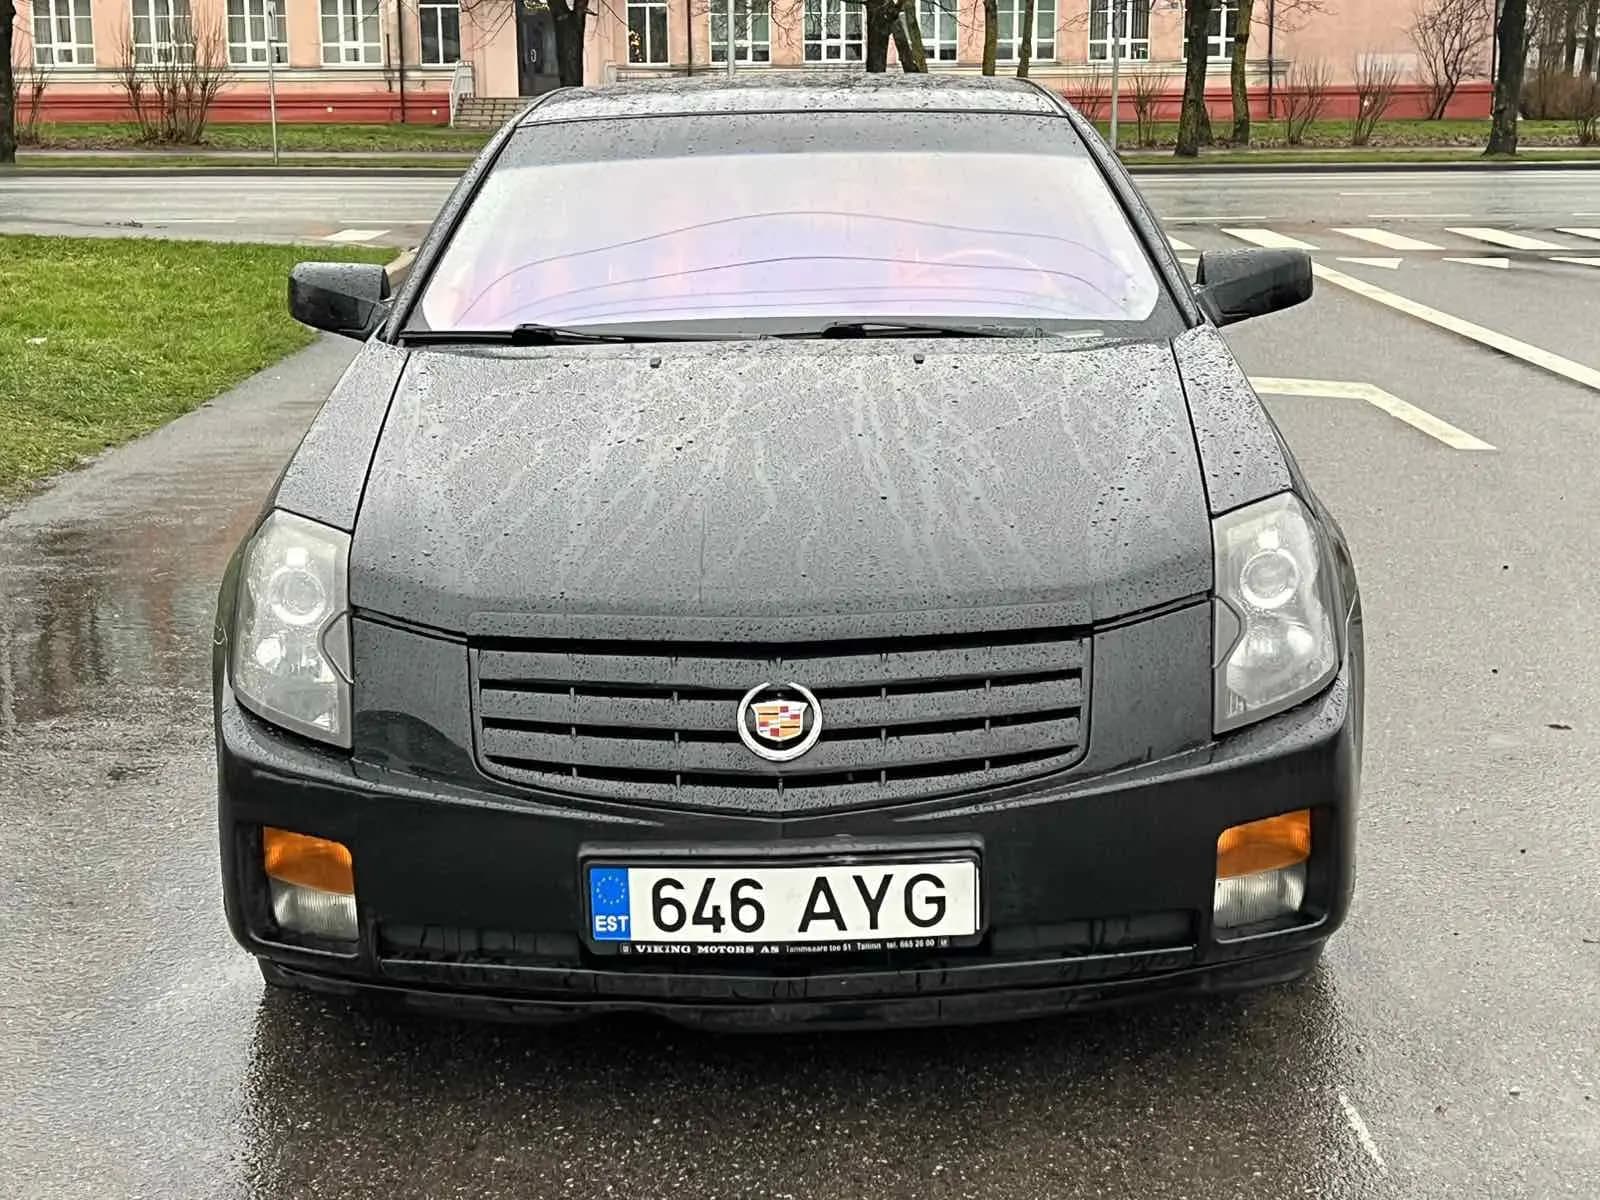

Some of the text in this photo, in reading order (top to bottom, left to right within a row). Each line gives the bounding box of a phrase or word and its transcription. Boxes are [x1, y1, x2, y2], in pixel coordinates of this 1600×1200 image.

[651, 873, 946, 933] 646 AYG
[594, 915, 629, 932] EST
[635, 944, 692, 954] VIKING
[696, 944, 755, 954] MOTORS
[759, 944, 780, 954] AS
